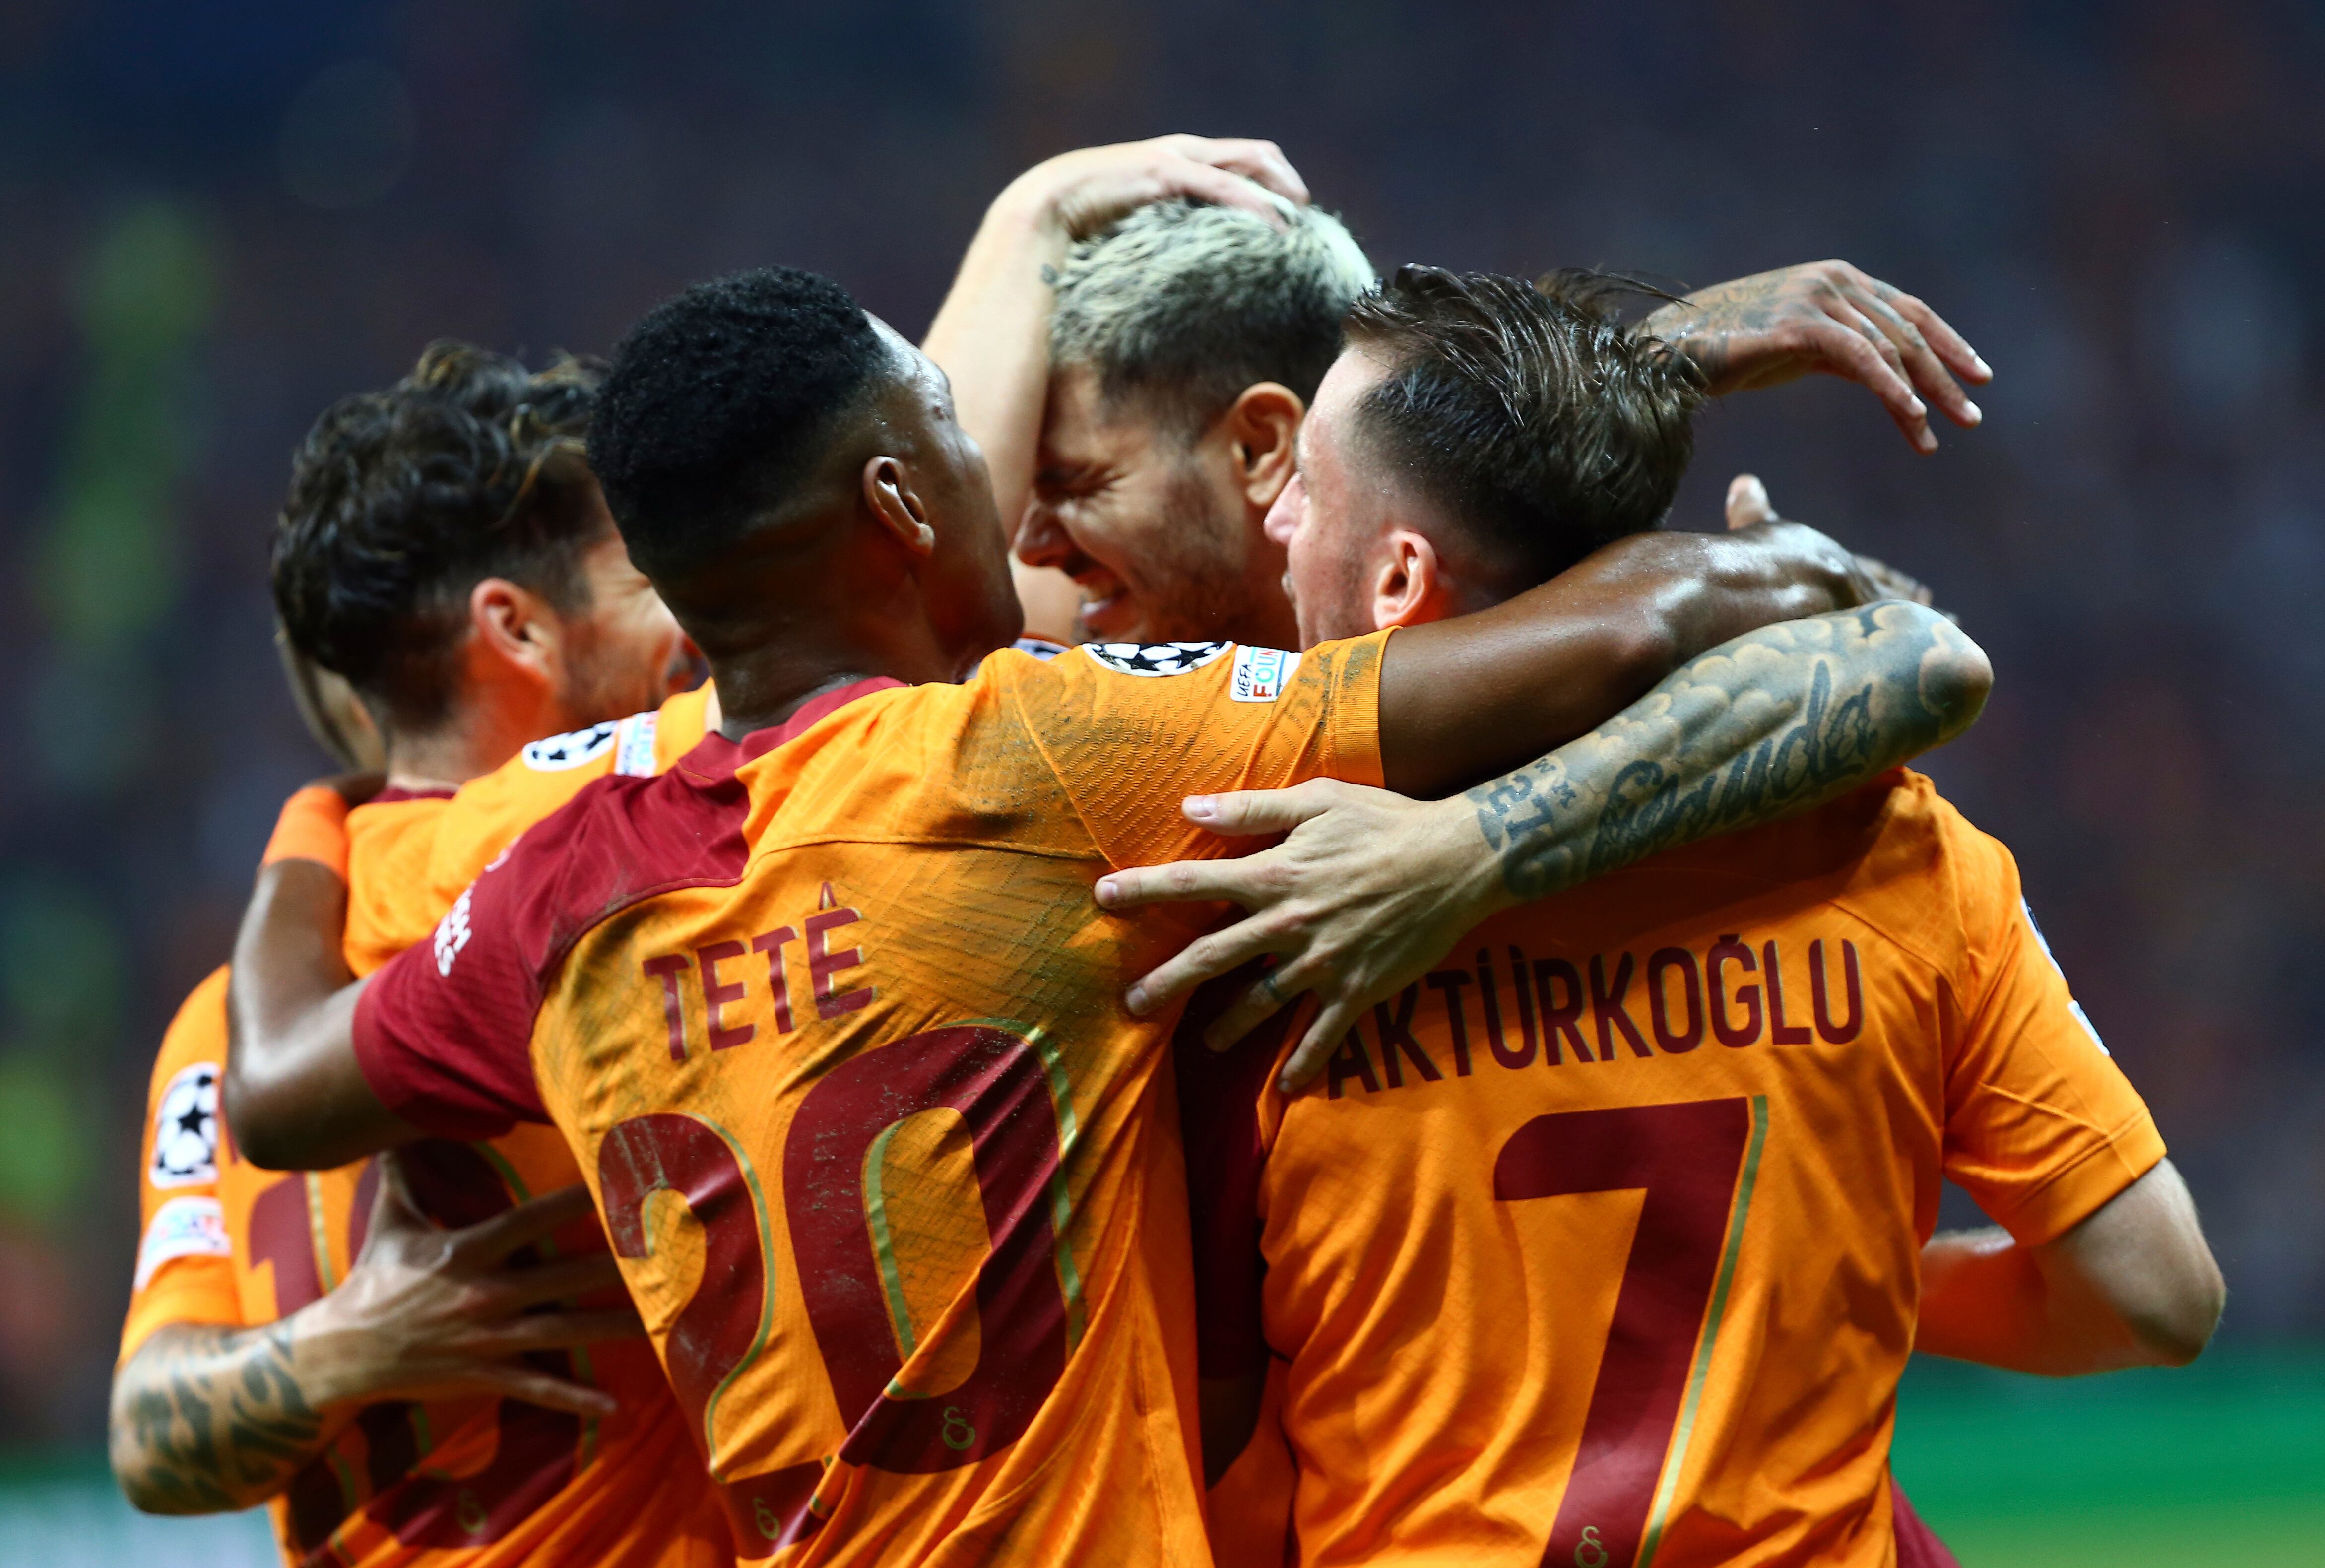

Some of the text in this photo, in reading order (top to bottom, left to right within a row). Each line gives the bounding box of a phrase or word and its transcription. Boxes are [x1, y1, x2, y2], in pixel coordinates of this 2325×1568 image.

[1237, 664, 1252, 696] UEFA
[642, 880, 875, 1061] TETÊ
[1327, 934, 1864, 1101] AKTÜRKOĞLU
[598, 1019, 1079, 1561] 20
[1493, 1095, 1764, 1568] 7
